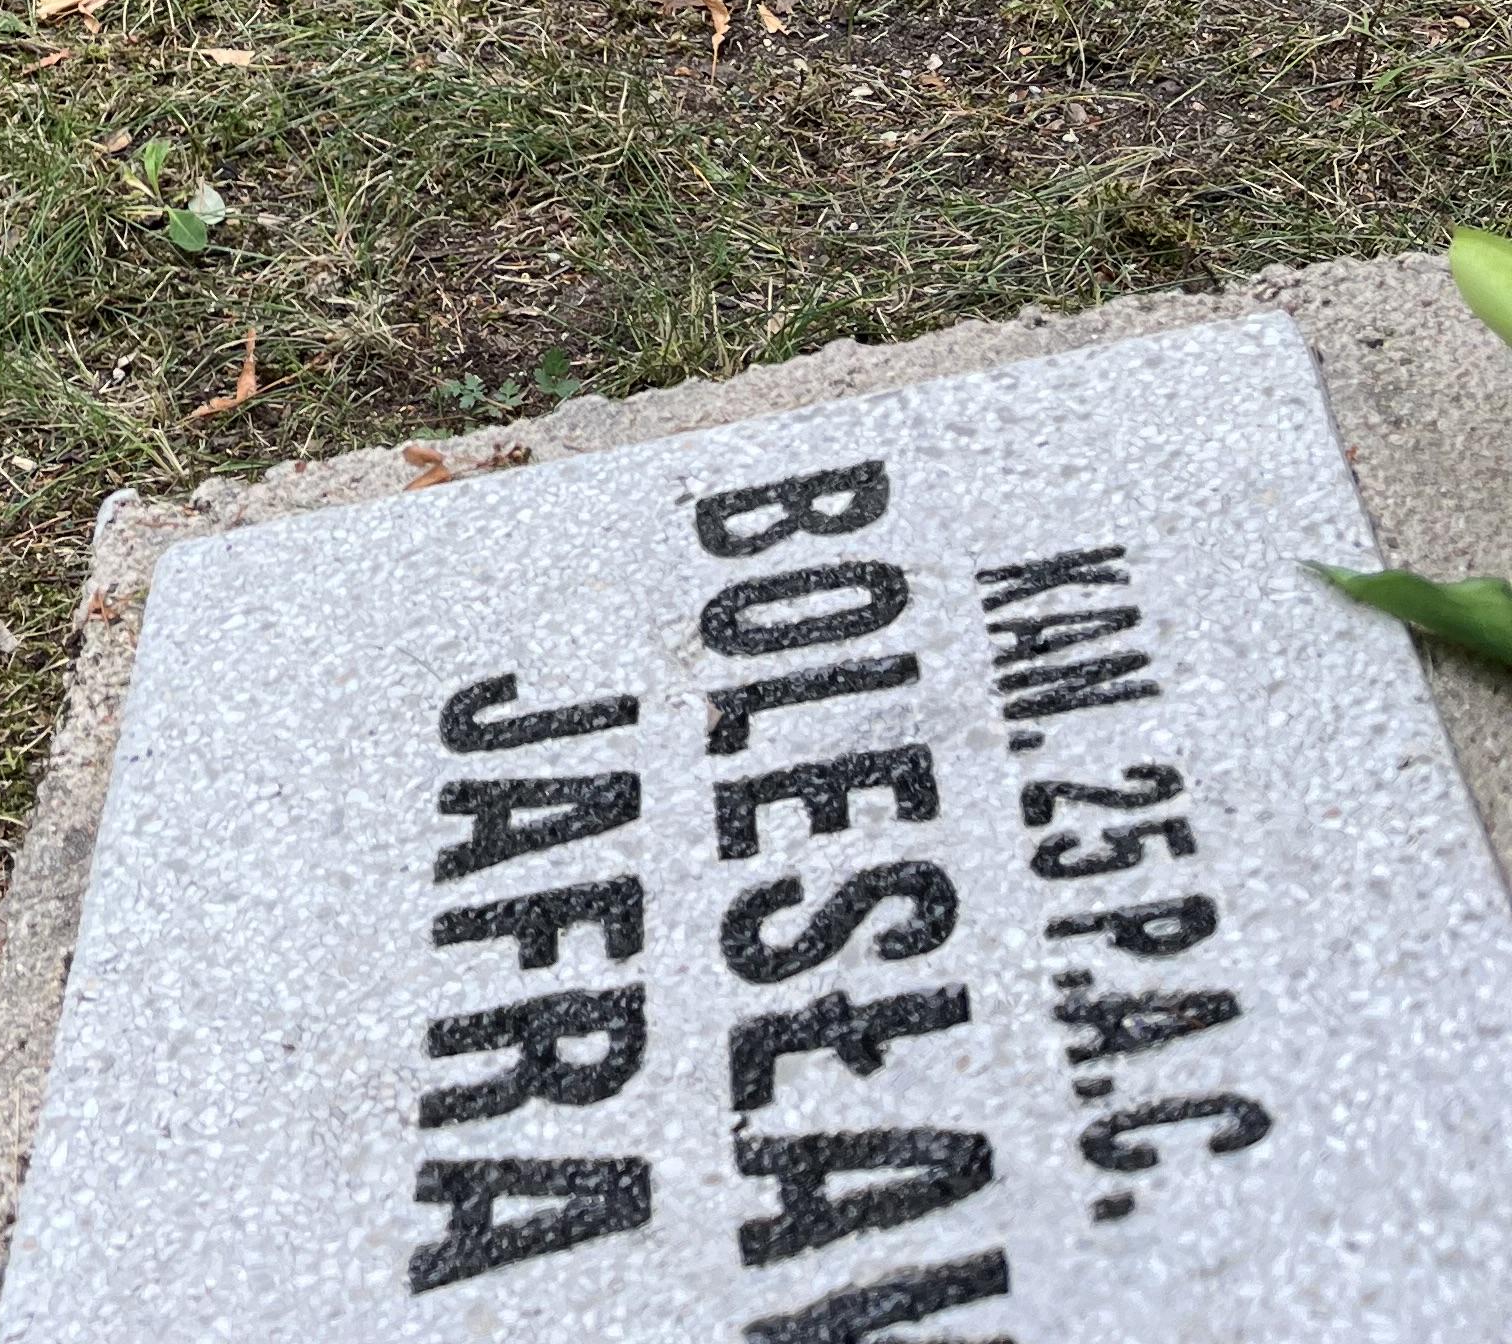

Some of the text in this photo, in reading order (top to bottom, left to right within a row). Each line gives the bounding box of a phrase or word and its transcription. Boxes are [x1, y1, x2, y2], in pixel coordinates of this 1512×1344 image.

[976, 545, 1160, 752] KAN.
[407, 674, 652, 1294] JAFRA
[1045, 893, 1273, 1224] P.A.C.
